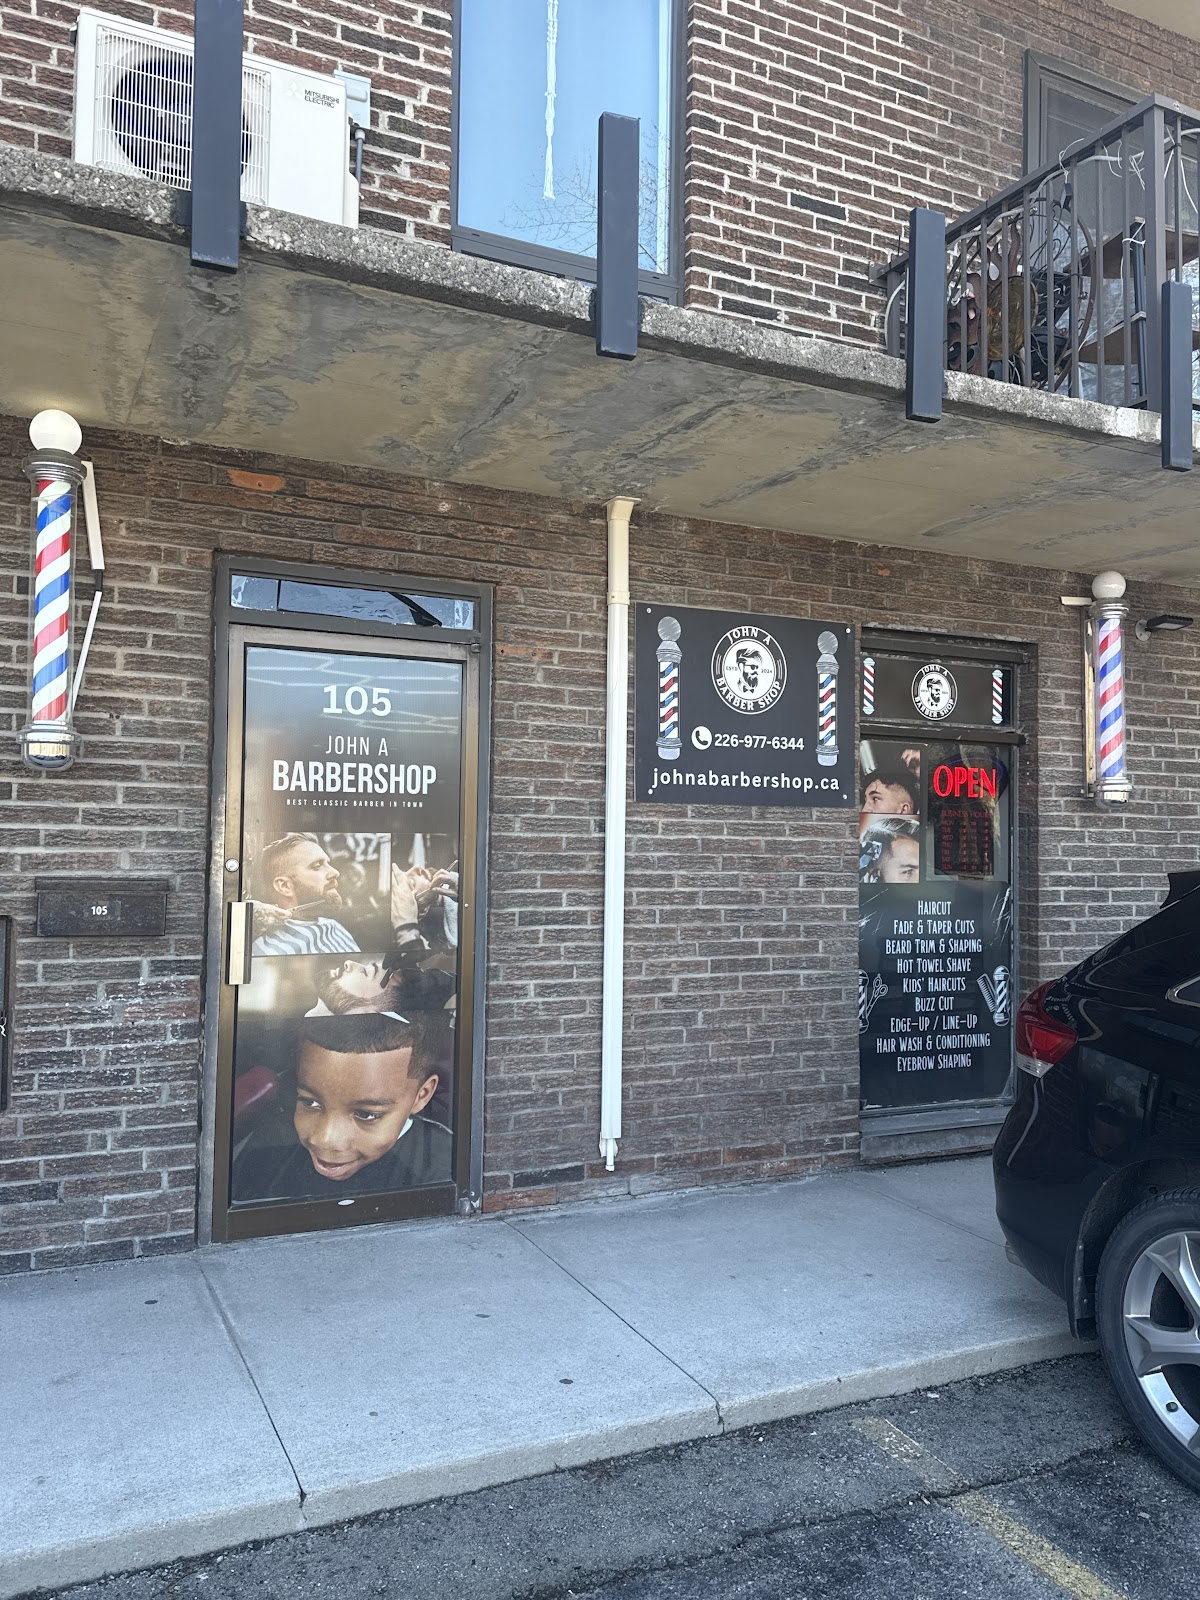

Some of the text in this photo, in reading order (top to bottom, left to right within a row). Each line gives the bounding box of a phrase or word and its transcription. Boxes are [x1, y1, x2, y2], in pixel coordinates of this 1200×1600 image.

[304, 95, 335, 109] ELECTRIC
[305, 89, 340, 104] MITSUBISHI
[726, 626, 772, 646] JOHN A
[942, 669, 949, 677] A
[323, 685, 392, 717] 105
[716, 676, 782, 711] BARBER SHOP
[914, 696, 954, 718] BARBER SHOP
[325, 735, 389, 757] JOHN A
[714, 733, 805, 751] 226-977-6344
[272, 759, 437, 795] BARBERSHOP
[652, 767, 840, 793] johnabarbershop.ca
[933, 765, 997, 799] OPEN
[286, 798, 308, 806] BEST
[312, 799, 348, 807] CLASSIC
[353, 799, 385, 807] BARBER
[389, 800, 398, 808] IN
[941, 810, 968, 818] BUSINESS
[90, 905, 108, 916] 105
[917, 900, 952, 916] HAIRCUT
[893, 919, 975, 935] FADE & TAPER CUTS
[885, 938, 983, 954] BEARD TRIM & SHAPING
[897, 957, 972, 974] HOT TOWEL SHAVE
[928, 976, 966, 992] HAIRCUTS
[915, 995, 955, 1012] BUZZ CUT
[890, 1013, 978, 1033] EDGE-UP / LINE-UP
[876, 1033, 991, 1053] HAIR WASH & CONDITIONING
[897, 1053, 972, 1072] EYEBROW SHAPING
